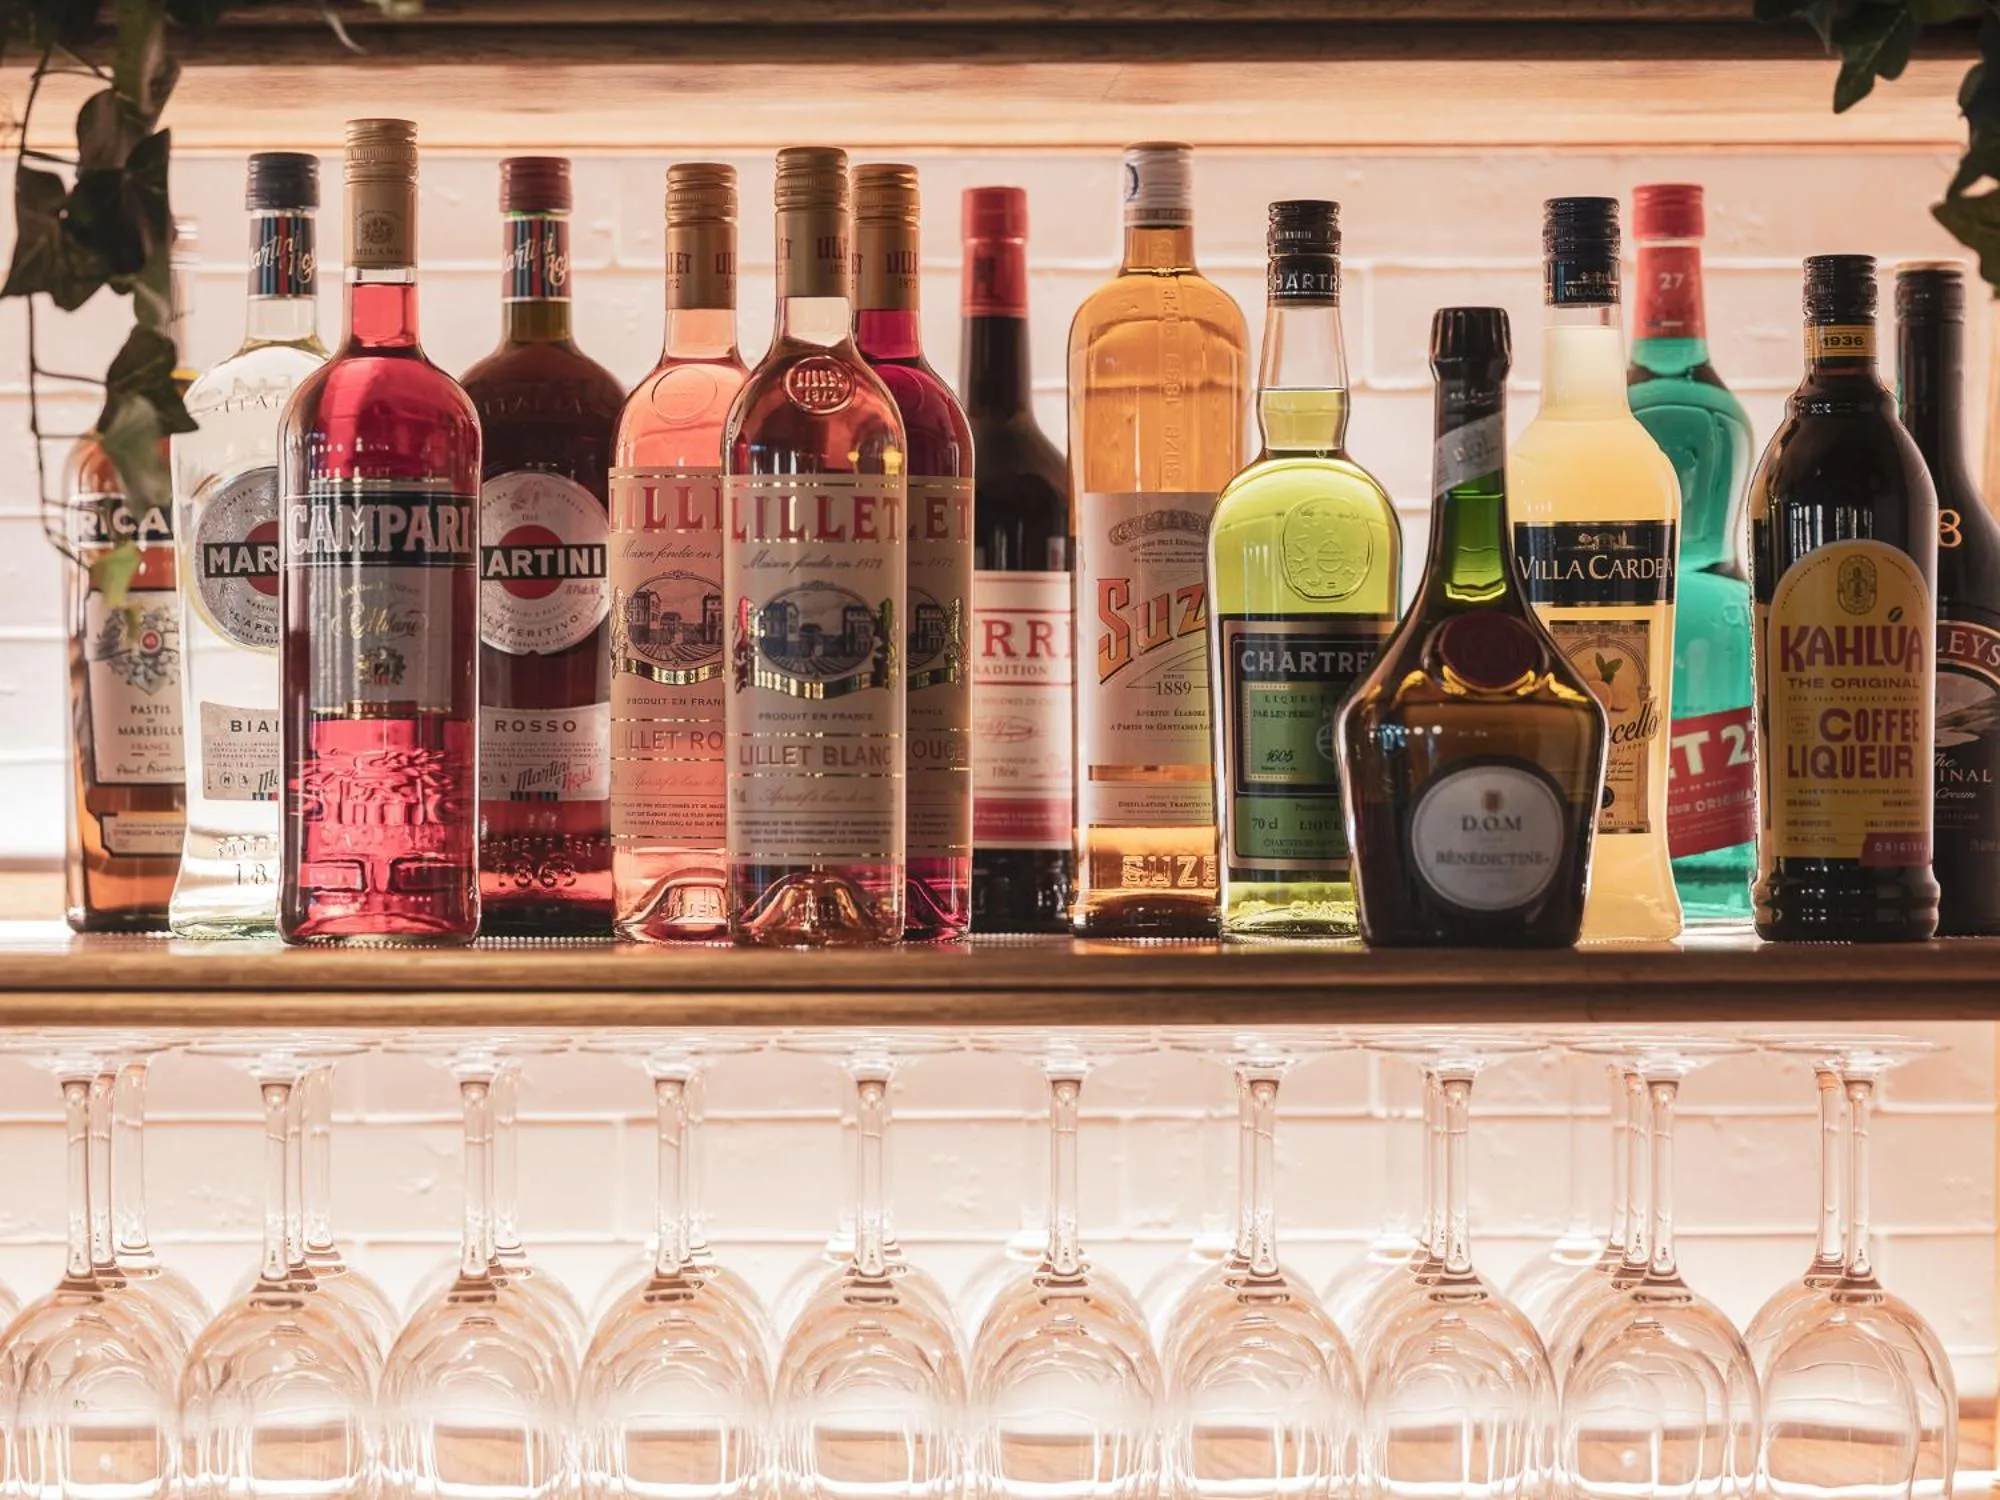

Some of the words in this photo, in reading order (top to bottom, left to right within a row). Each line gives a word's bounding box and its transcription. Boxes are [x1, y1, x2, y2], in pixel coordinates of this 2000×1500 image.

[1659, 271, 1684, 289] 27
[1823, 335, 1864, 346] 1936
[287, 504, 472, 556] CAMPARI
[731, 495, 901, 543] LILLET
[906, 497, 971, 541] ET
[481, 547, 601, 576] ARTINI
[743, 549, 791, 568] Maison
[853, 558, 883, 569] 1872
[1518, 555, 1585, 581] VILLA
[982, 620, 1072, 658] RR
[1936, 630, 2000, 667] EYS
[1241, 650, 1376, 673] CHARTRE
[1154, 682, 1192, 697] 1889
[1787, 678, 1824, 688] THE
[1830, 678, 1921, 688] ORIGINAL
[130, 704, 171, 714] PASTIS
[671, 697, 686, 706] EN
[230, 720, 279, 733] BIA
[495, 720, 577, 733] ROSSO
[758, 712, 808, 721] PRODUIT
[812, 712, 828, 721] EN
[832, 712, 874, 721] FRANCE
[1609, 701, 1657, 745] cello
[1818, 708, 1920, 742] COFFEE
[739, 745, 811, 766] LILLET
[822, 745, 893, 767] BLANC
[1266, 749, 1295, 762] 1605
[1669, 730, 1710, 780] T
[1787, 745, 1914, 779] LIQUEUR
[516, 757, 571, 791] Martini
[1695, 788, 1755, 812] ORIGINA
[1935, 787, 1977, 799] Cream
[1251, 818, 1265, 830] 70
[1269, 816, 1278, 830] cl
